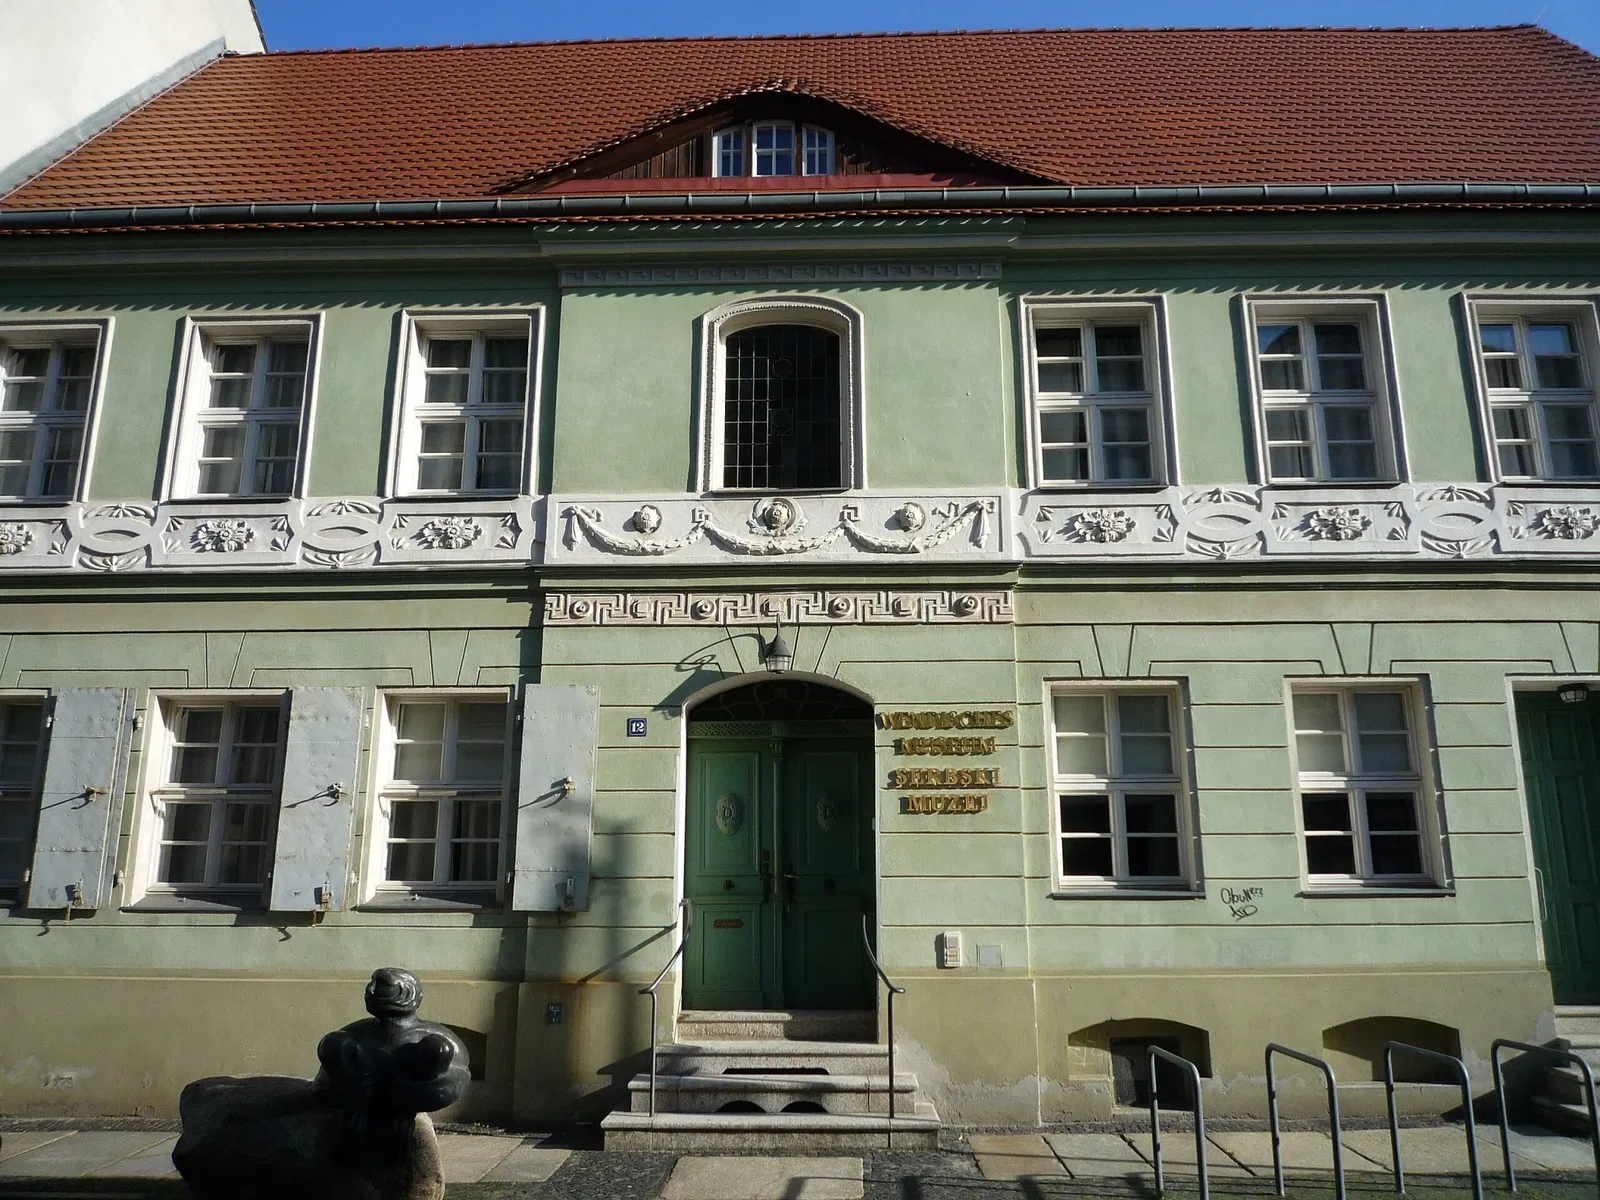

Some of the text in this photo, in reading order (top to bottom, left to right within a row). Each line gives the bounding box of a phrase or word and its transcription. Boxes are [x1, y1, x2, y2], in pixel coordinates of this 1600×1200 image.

[631, 721, 645, 733] 12
[878, 710, 1015, 729] WENDISCHES
[898, 736, 997, 754] MUSEUM
[894, 767, 1001, 786] SERBSKI
[905, 793, 990, 812] MUZEJ
